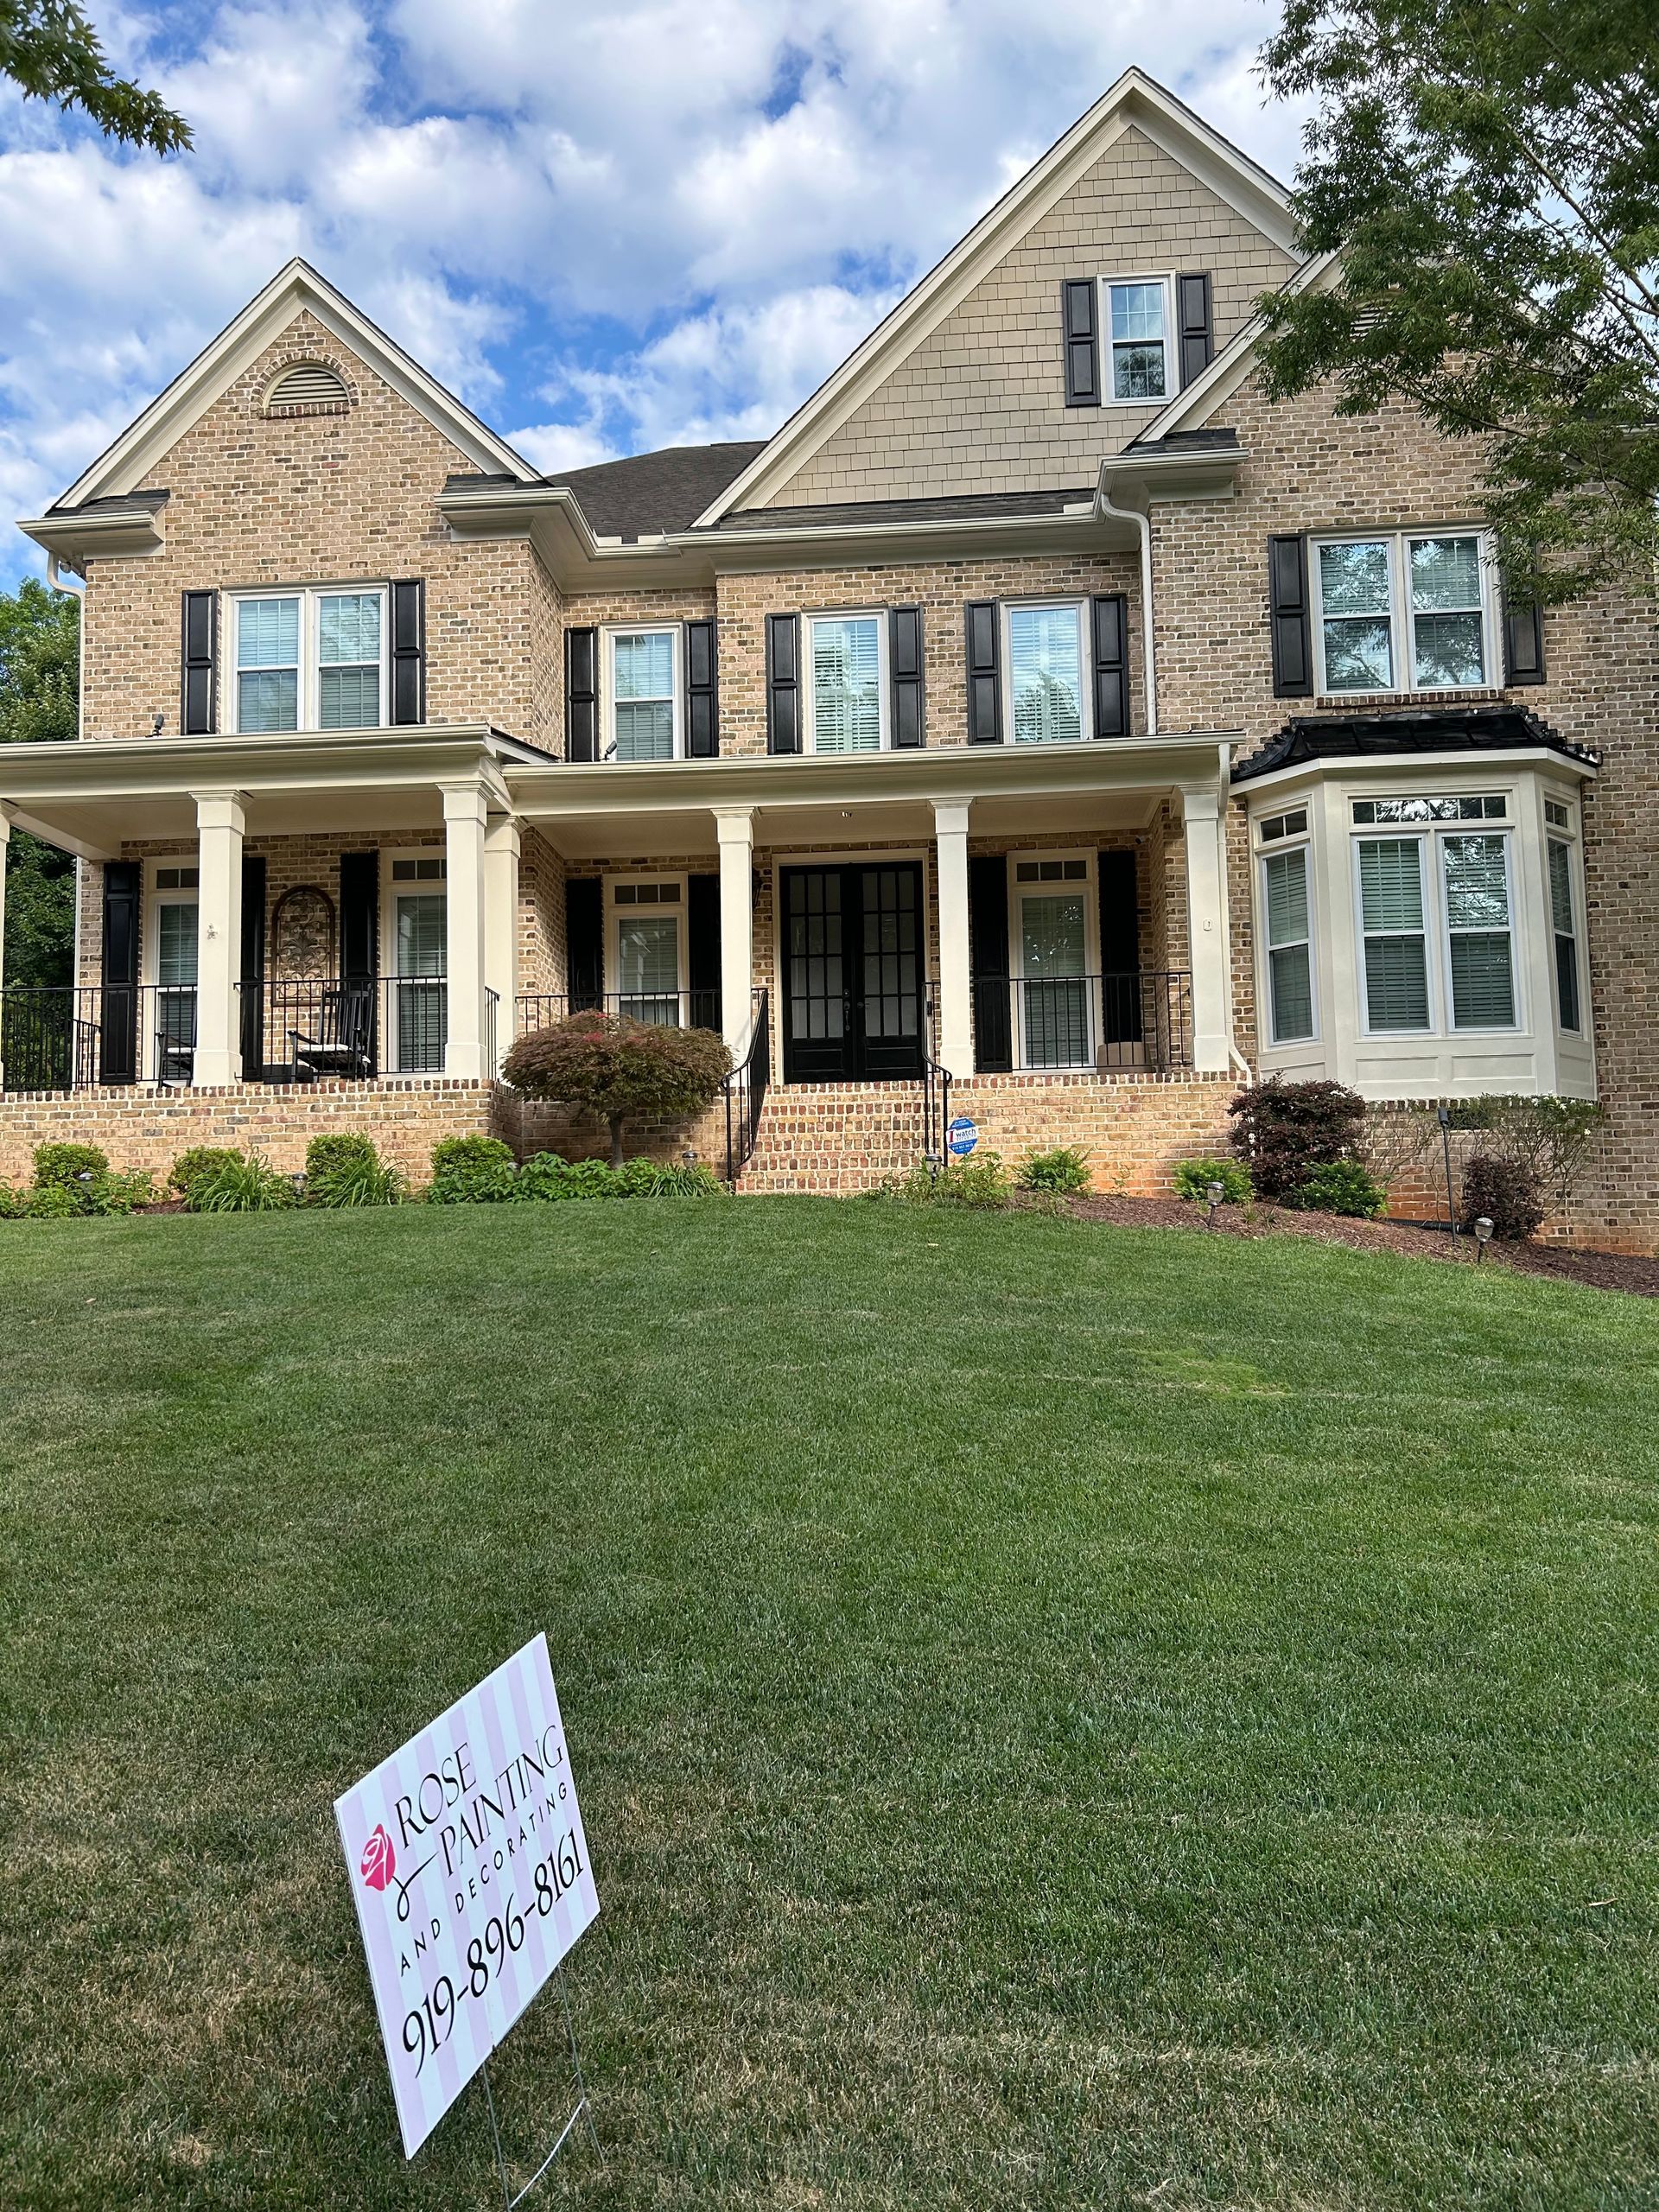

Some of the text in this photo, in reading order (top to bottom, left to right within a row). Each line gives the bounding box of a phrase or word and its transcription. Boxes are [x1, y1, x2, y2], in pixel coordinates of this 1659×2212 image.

[956, 1128, 976, 1137] watch
[394, 1742, 477, 1850] ROSE
[439, 1725, 564, 1878] PAINTING
[401, 1782, 568, 1977] AND DECORATING
[402, 1827, 584, 2079] 919-896-8161
